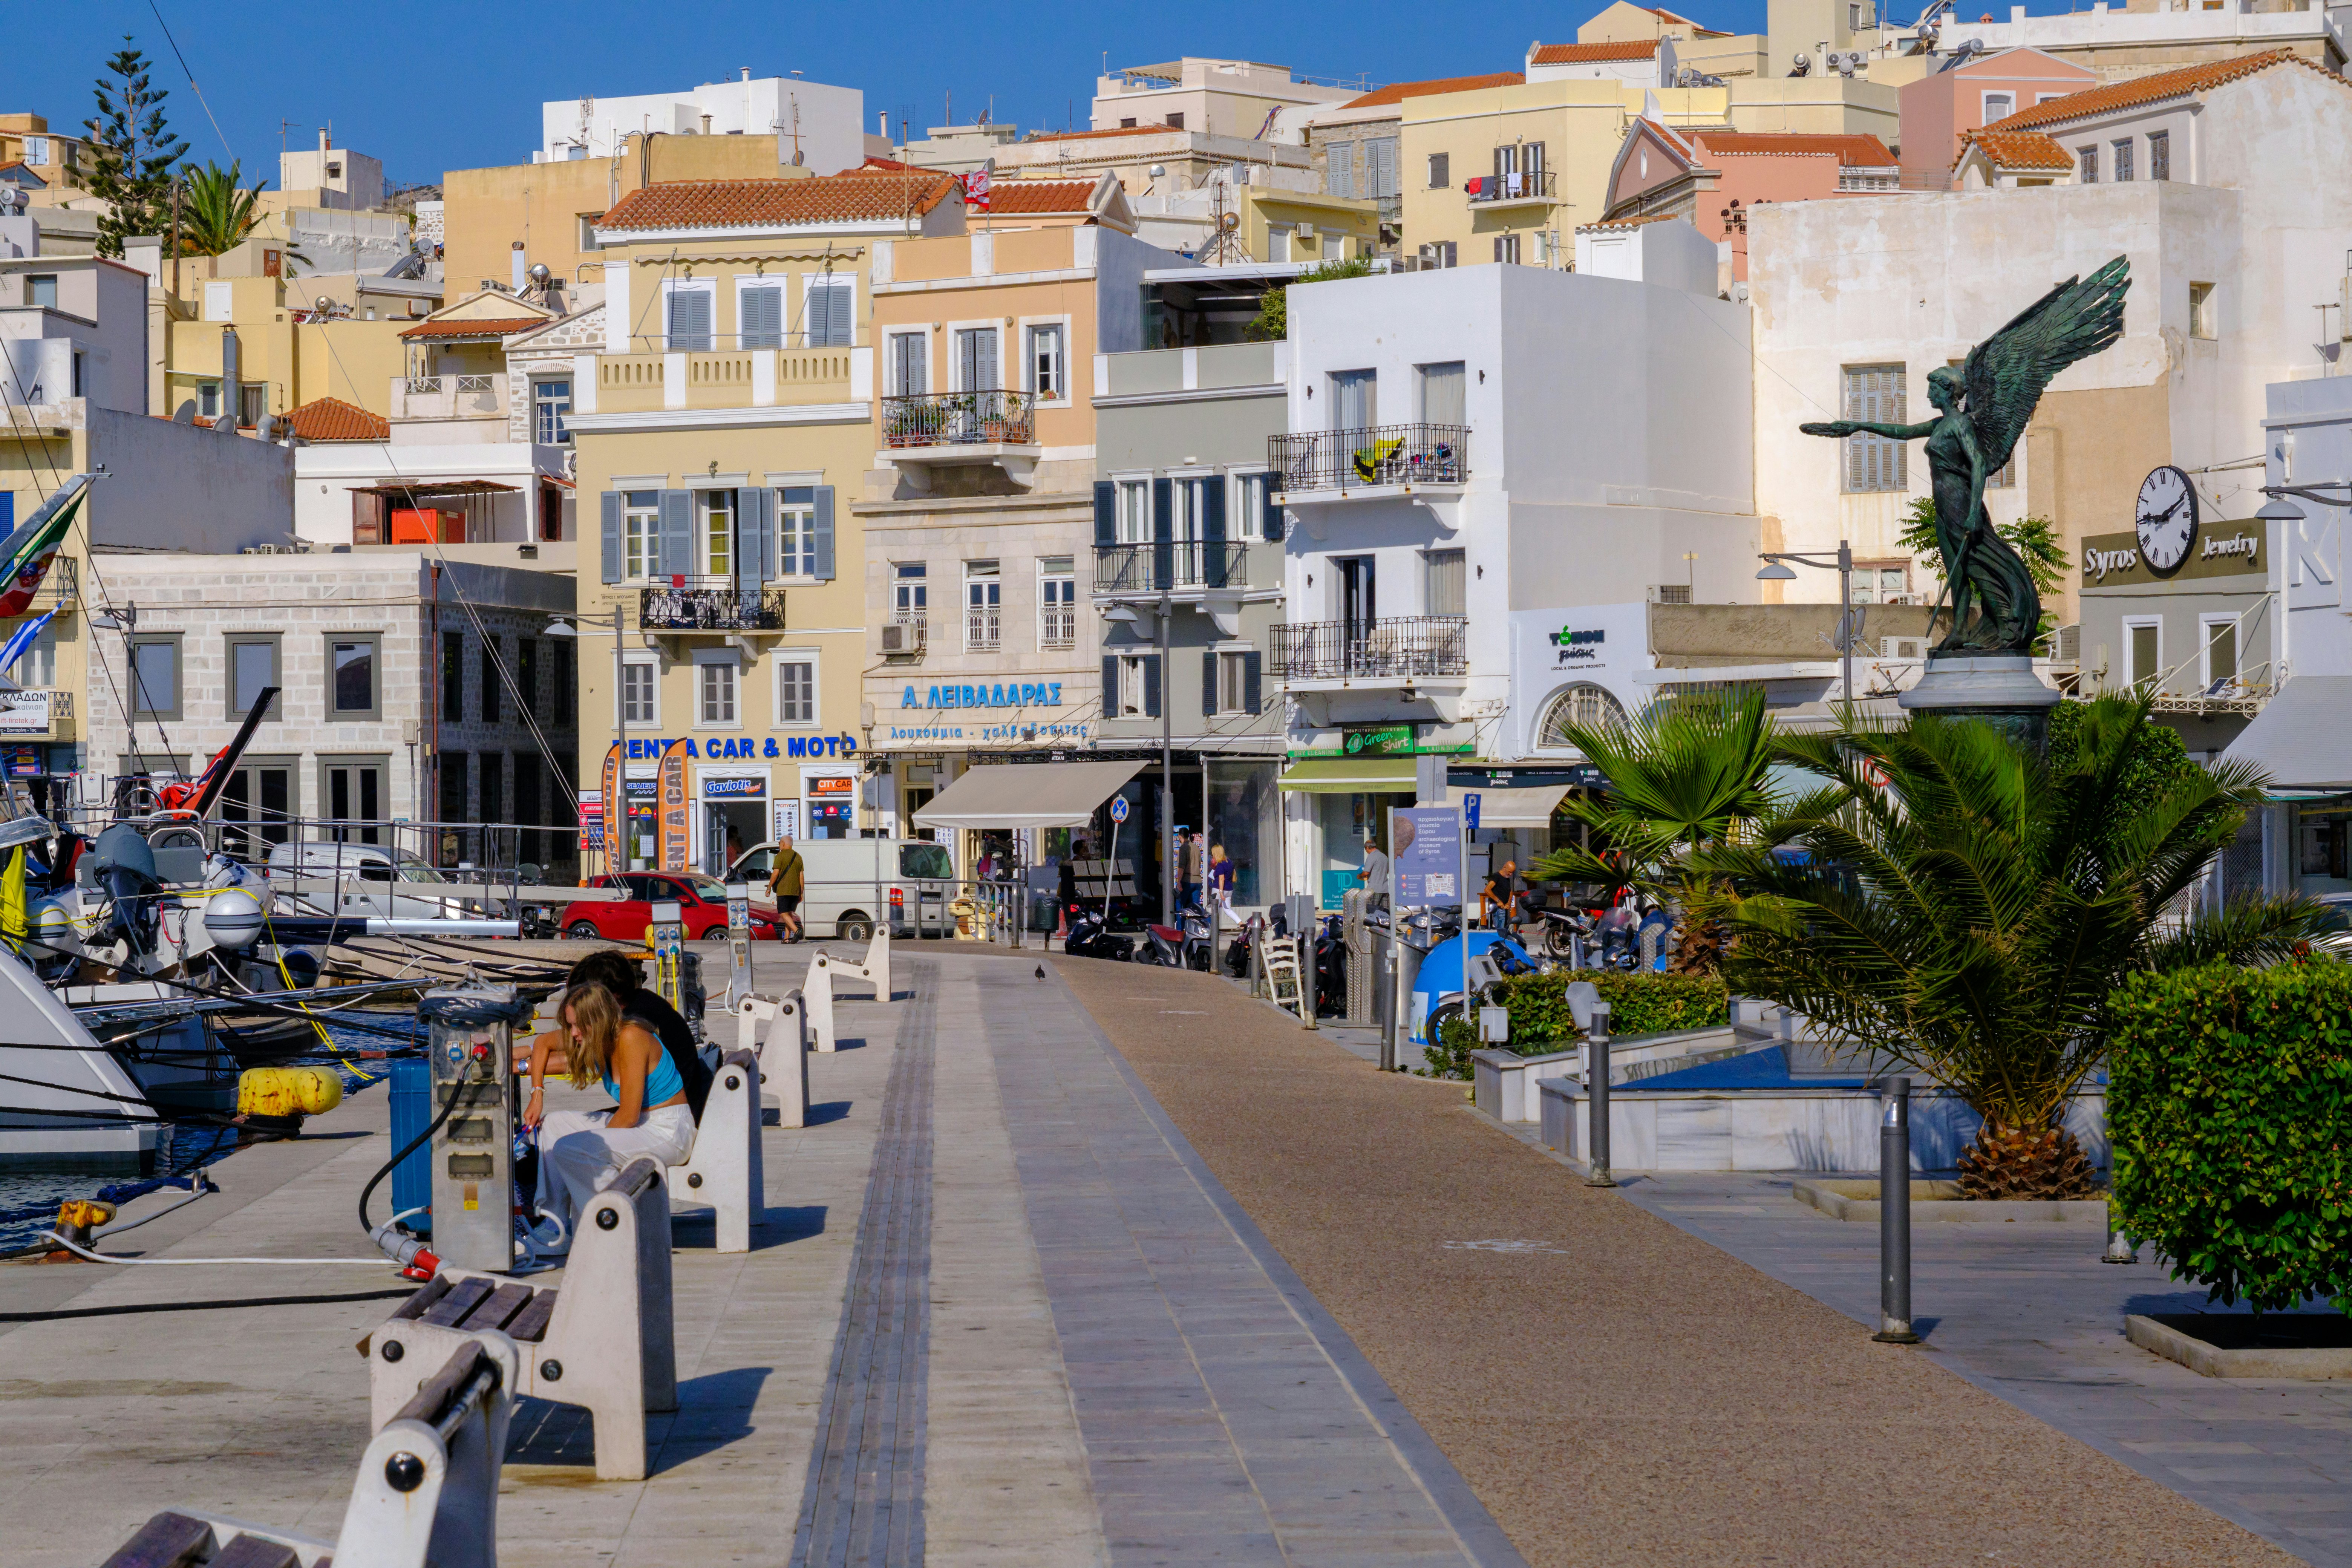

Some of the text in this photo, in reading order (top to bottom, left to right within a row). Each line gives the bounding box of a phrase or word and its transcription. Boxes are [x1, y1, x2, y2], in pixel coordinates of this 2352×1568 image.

[2084, 532, 2258, 579] Syros Jewelry
[901, 683, 1062, 709] Α. ΛΕΙΒΑΔΑΡΑΣ
[891, 727, 963, 740] λουκουμια
[1364, 732, 1393, 746] Green
[706, 738, 754, 757] CAR
[764, 737, 779, 757] &
[788, 737, 856, 756] MOTO
[1382, 737, 1409, 752] Shirt
[665, 756, 684, 805] CAR
[706, 779, 751, 793] Gaviotis
[745, 783, 761, 792] travel
[1467, 796, 1477, 813] P
[666, 809, 685, 826] A
